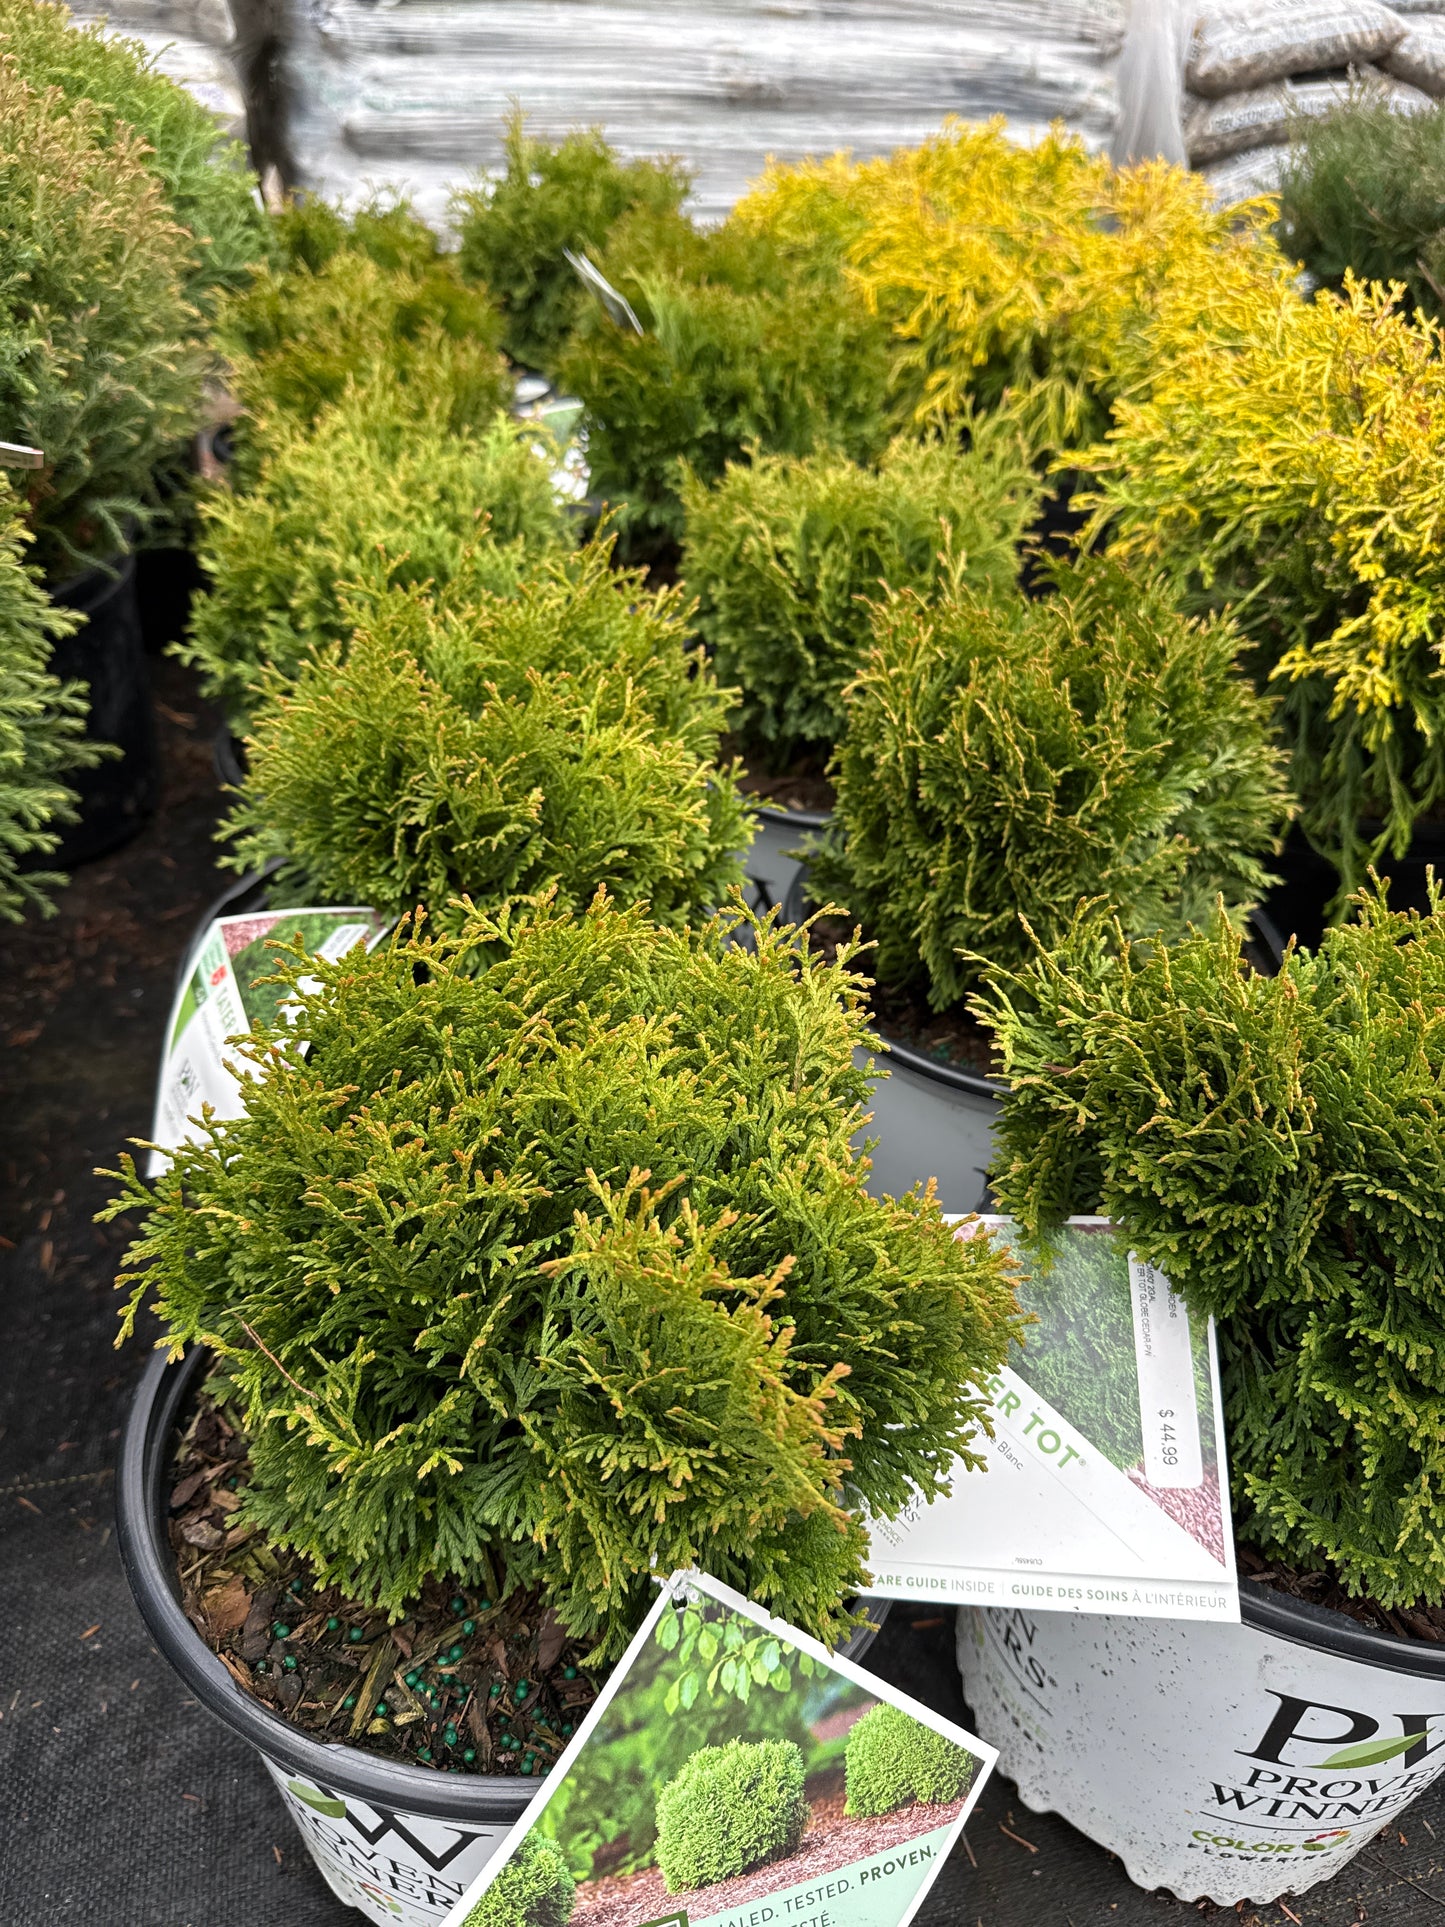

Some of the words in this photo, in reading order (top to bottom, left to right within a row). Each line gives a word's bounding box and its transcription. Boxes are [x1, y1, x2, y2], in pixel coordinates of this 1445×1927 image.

[1137, 1262, 1146, 1277] TER
[1140, 1293, 1149, 1317] GLOBE
[981, 1375, 1021, 1418] ER
[1157, 1409, 1175, 1418] $
[997, 1440, 1024, 1471] Blanc
[1160, 1423, 1178, 1465] 44.99
[875, 1574, 902, 1587] ARE
[906, 1576, 947, 1589] GUIDE
[951, 1579, 995, 1593] INSIDE
[1011, 1584, 1053, 1597] GUIDE
[1058, 1586, 1083, 1600] DES
[1087, 1589, 1129, 1602] SOINS
[1132, 1590, 1142, 1603] À
[1145, 1591, 1227, 1609] L'INTÉRIEUR
[1210, 1778, 1435, 1820] WINNER
[1187, 1843, 1333, 1863] FLOWERING
[1191, 1830, 1296, 1853] COLOR
[784, 1878, 855, 1914] TESTED.
[859, 1845, 938, 1886] PROVEN.
